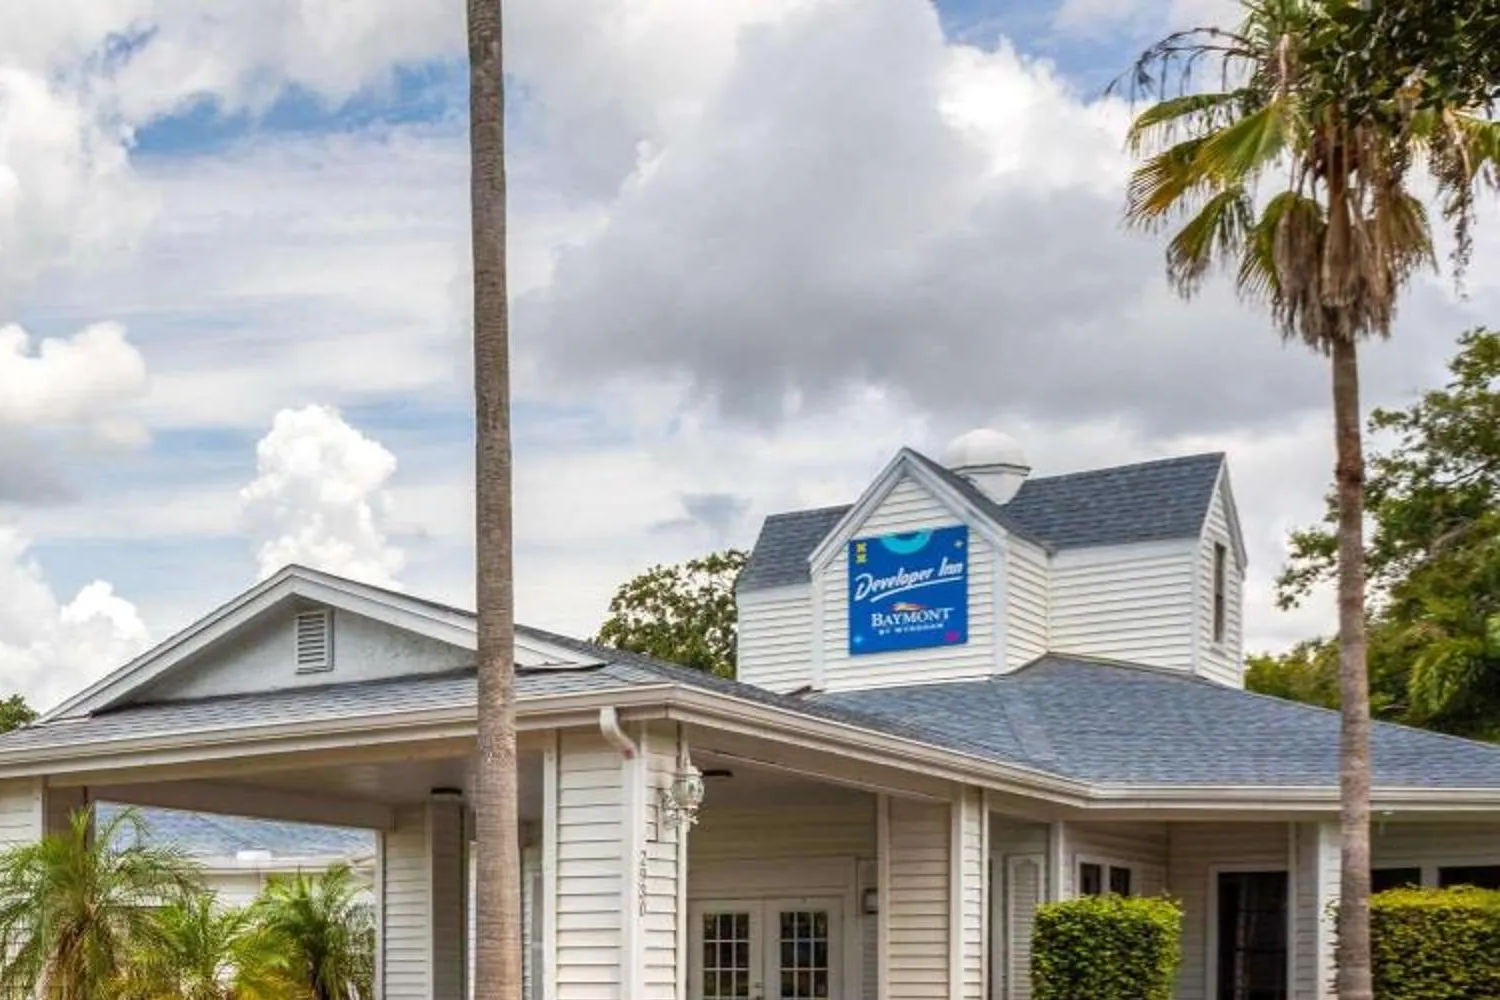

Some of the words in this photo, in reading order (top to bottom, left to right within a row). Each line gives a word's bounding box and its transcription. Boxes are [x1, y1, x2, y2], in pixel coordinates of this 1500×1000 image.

[854, 566, 934, 601] Developer
[938, 556, 963, 577] Inn
[871, 607, 955, 628] BAYMONT
